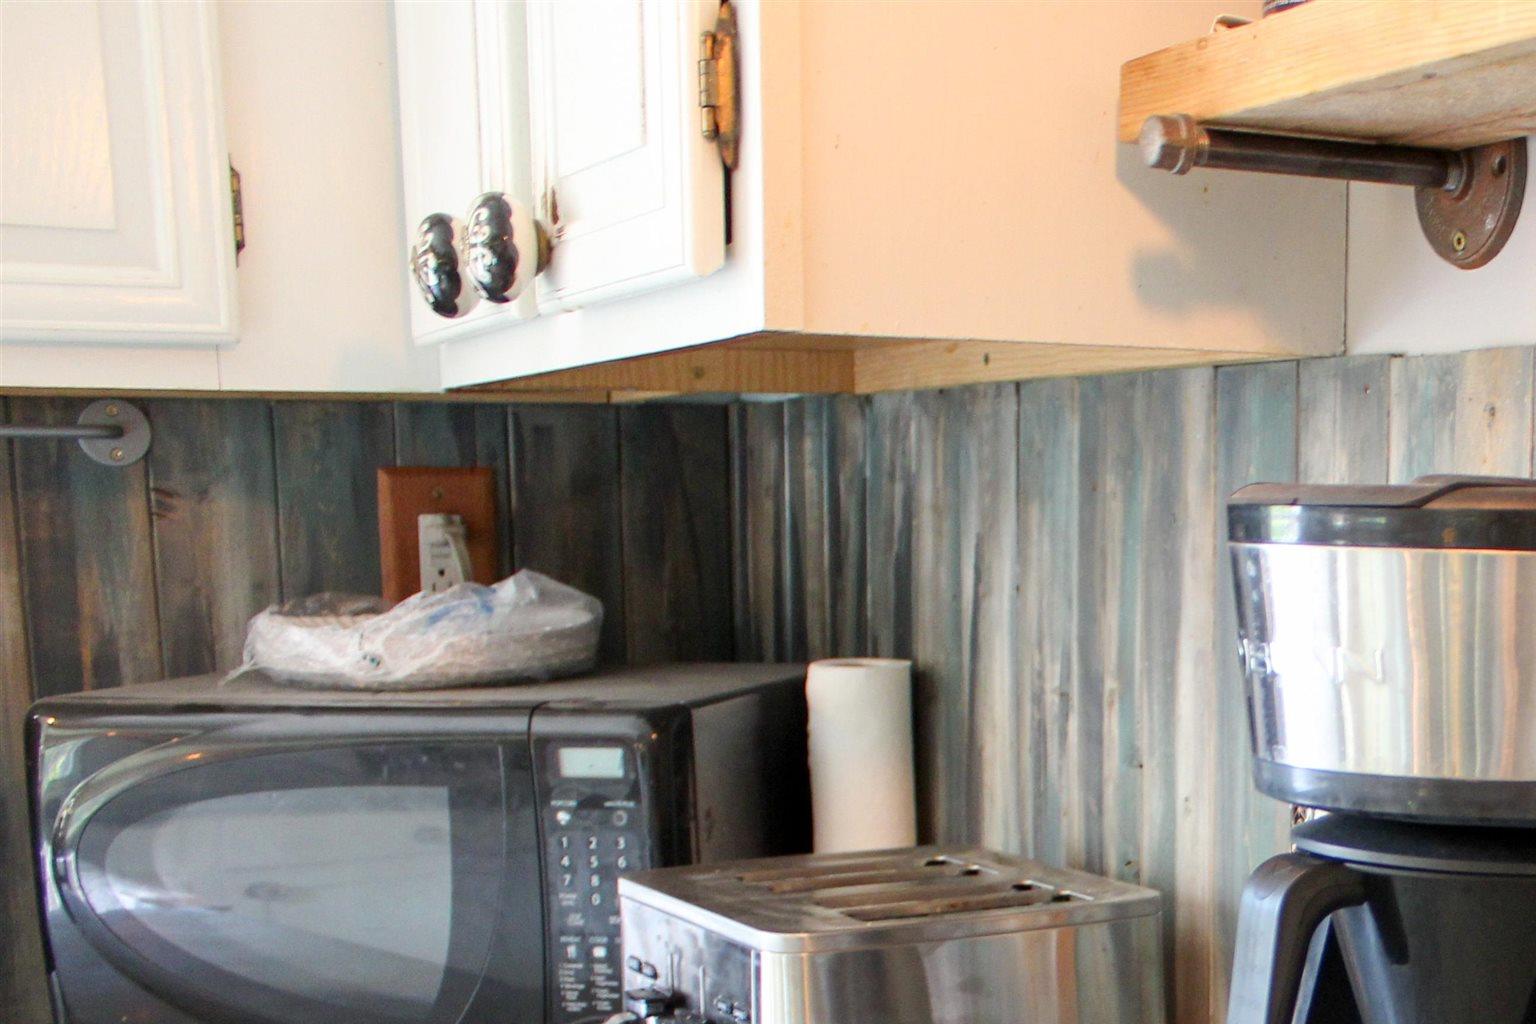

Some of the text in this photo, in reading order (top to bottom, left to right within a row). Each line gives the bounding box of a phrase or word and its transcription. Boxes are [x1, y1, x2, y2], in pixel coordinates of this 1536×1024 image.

[562, 835, 625, 850] 1 2 3
[560, 854, 626, 869] 4 5 6
[563, 873, 600, 887] 7 8
